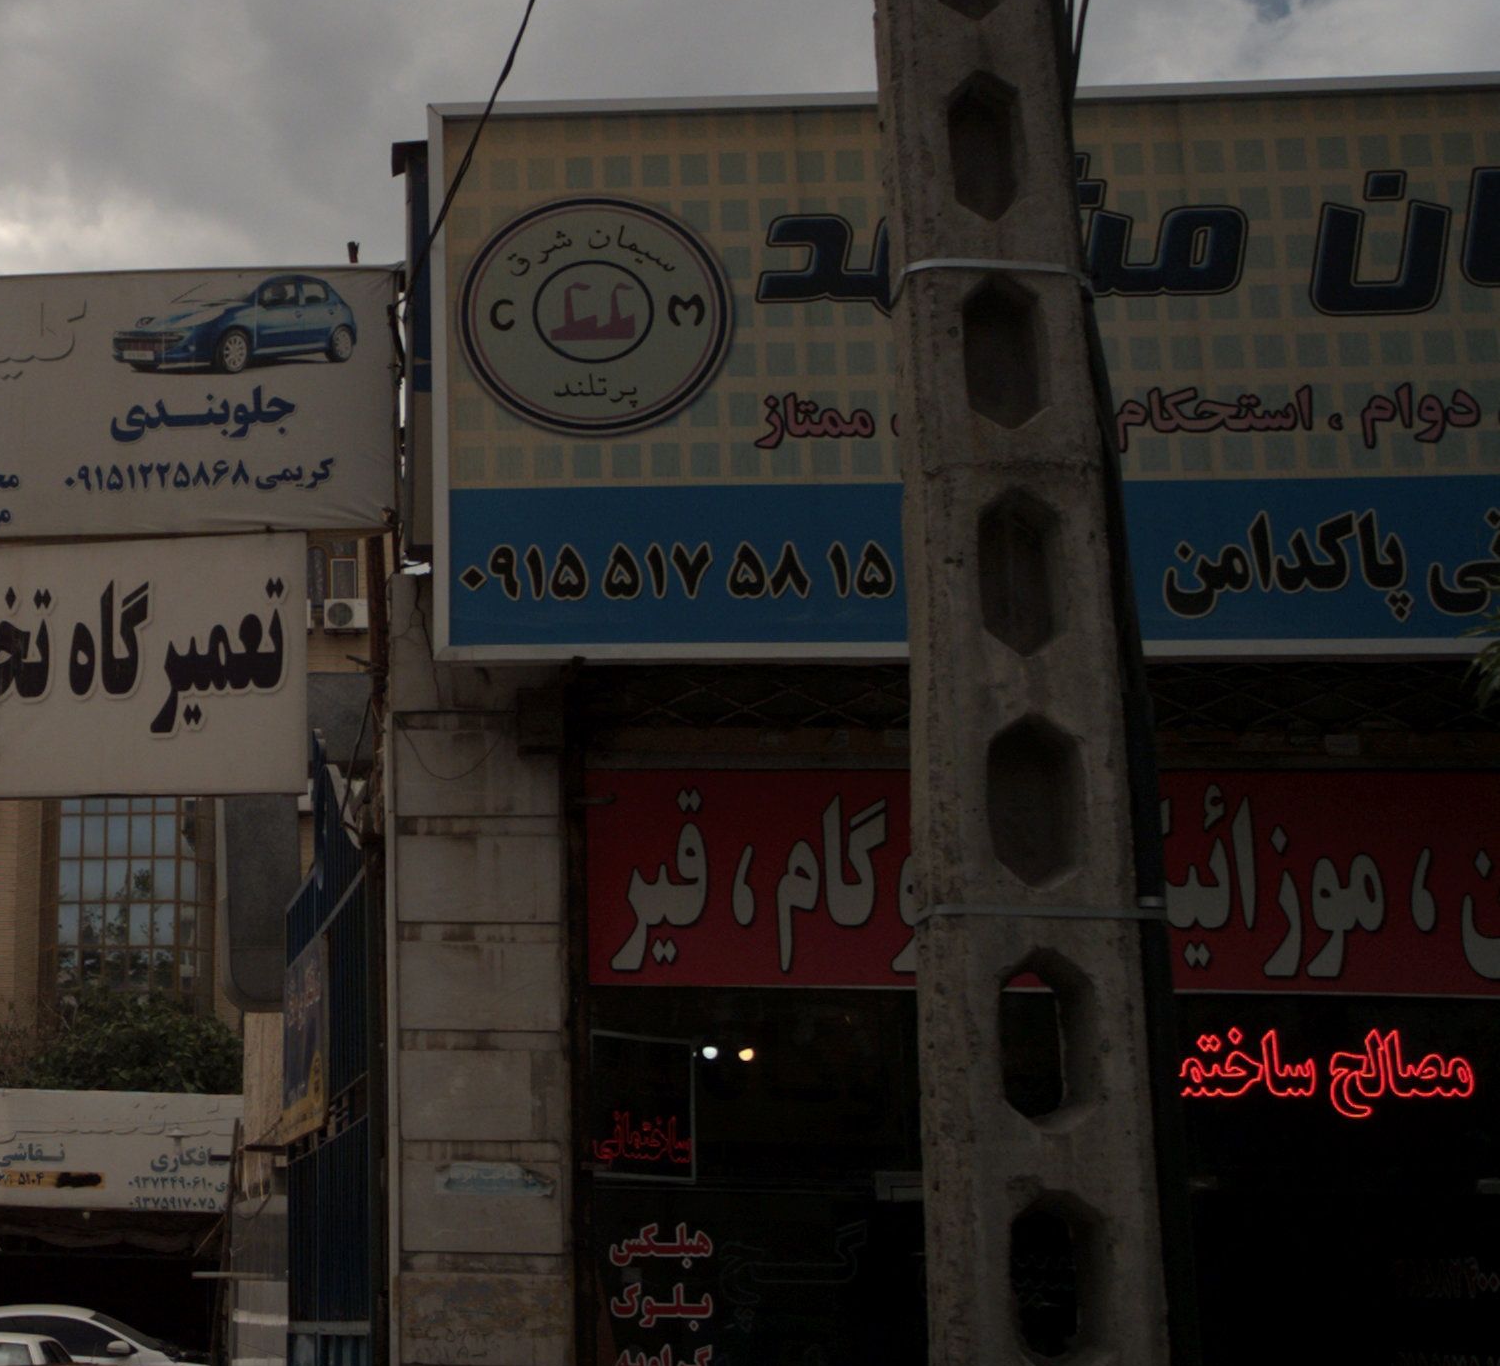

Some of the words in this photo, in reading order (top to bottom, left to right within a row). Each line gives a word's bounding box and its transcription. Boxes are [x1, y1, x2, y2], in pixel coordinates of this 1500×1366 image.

[506, 230, 573, 277] شرق
[587, 225, 677, 273] سیمان
[110, 385, 296, 442] جلوبندی
[553, 374, 638, 408] پرتلند
[1115, 385, 1313, 452] استحکام
[1360, 382, 1481, 447] دوام
[756, 394, 874, 448] ممتاز
[255, 457, 335, 490] کریمی
[1163, 508, 1413, 622] پاکدامن
[609, 787, 708, 972] قیر
[1328, 1027, 1477, 1119] مصالح
[609, 1283, 715, 1332] بلوک
